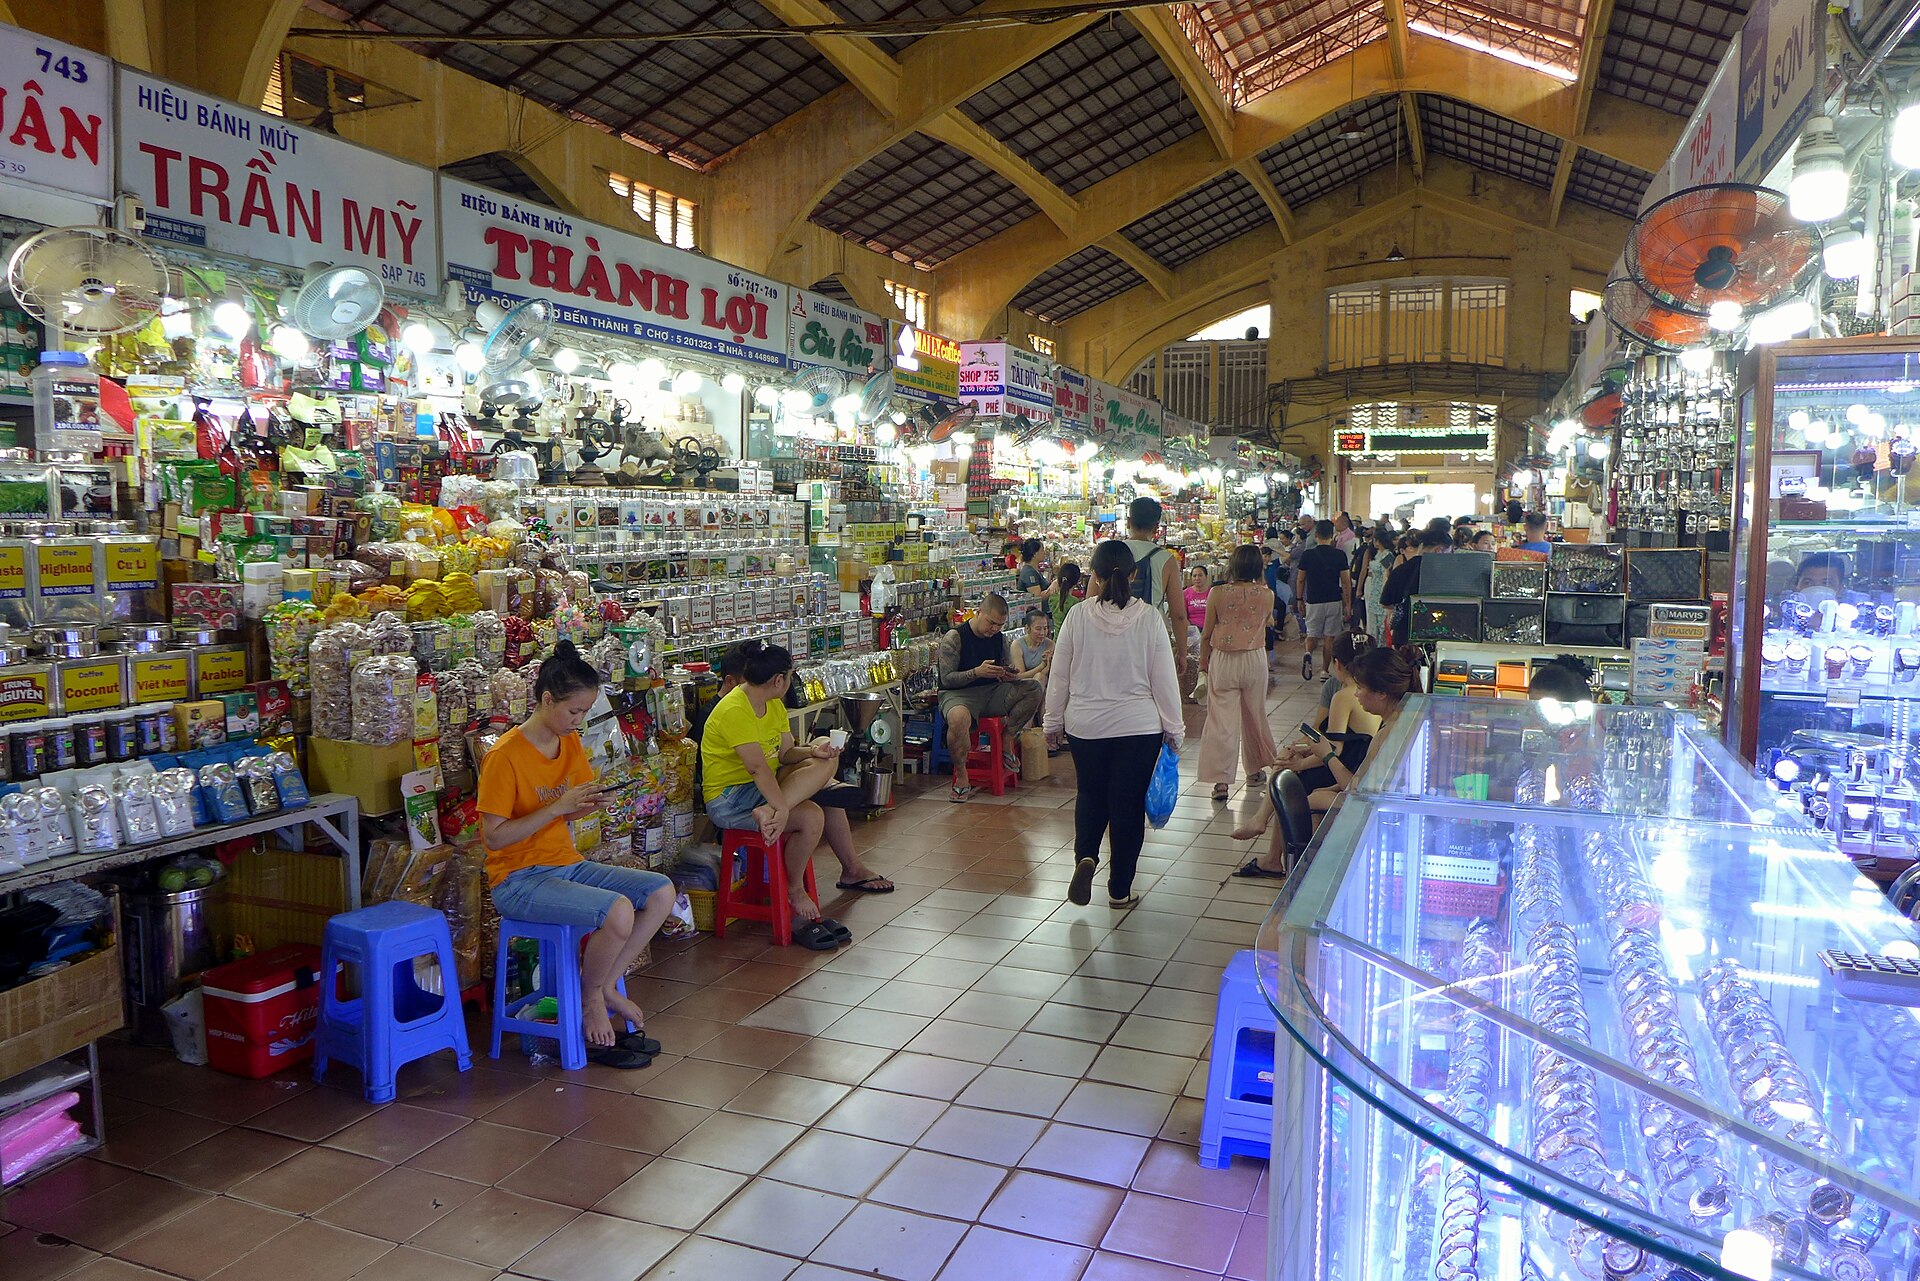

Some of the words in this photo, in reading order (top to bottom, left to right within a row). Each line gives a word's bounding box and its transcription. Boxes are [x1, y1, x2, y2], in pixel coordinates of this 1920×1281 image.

[36, 47, 88, 83] 743
[138, 85, 188, 123] HIỆU
[196, 101, 251, 141] BÁNH
[259, 125, 299, 155] MỨT
[139, 141, 323, 244] TRẦN
[343, 198, 423, 266] MỸ
[460, 193, 496, 217] HIỆU
[501, 203, 541, 229] BÁNH
[544, 217, 573, 237] MỨT
[381, 263, 403, 289] SẠP
[407, 269, 426, 288] 745
[485, 227, 689, 320] THÀNH
[701, 293, 769, 344] LỢI
[813, 301, 830, 316] HIỆU
[831, 305, 848, 321] BÁNH
[564, 310, 588, 325] BẾN
[591, 317, 629, 332] THÀNH
[647, 328, 669, 342] CHỢ
[677, 335, 682, 344] 5
[684, 337, 713, 350] 201323
[754, 352, 779, 364] 448986
[960, 370, 981, 383] SHOP
[984, 370, 999, 382] 755
[1011, 362, 1024, 386] TÀI
[1025, 366, 1040, 390] ĐỨC
[53, 383, 87, 394] Lychee
[985, 400, 999, 413] PHÊ
[40, 563, 93, 577] Highland
[117, 560, 133, 570] Cu
[136, 559, 147, 569] Li
[1668, 609, 1703, 619] MARVIS
[1668, 627, 1702, 636] MARVIS
[78, 671, 104, 679] Coffee
[201, 668, 244, 681] Arabica
[3, 680, 31, 689] TRUNG
[162, 679, 186, 688] Nam
[65, 683, 119, 699] Coconut
[1, 707, 37, 717] Legendee
